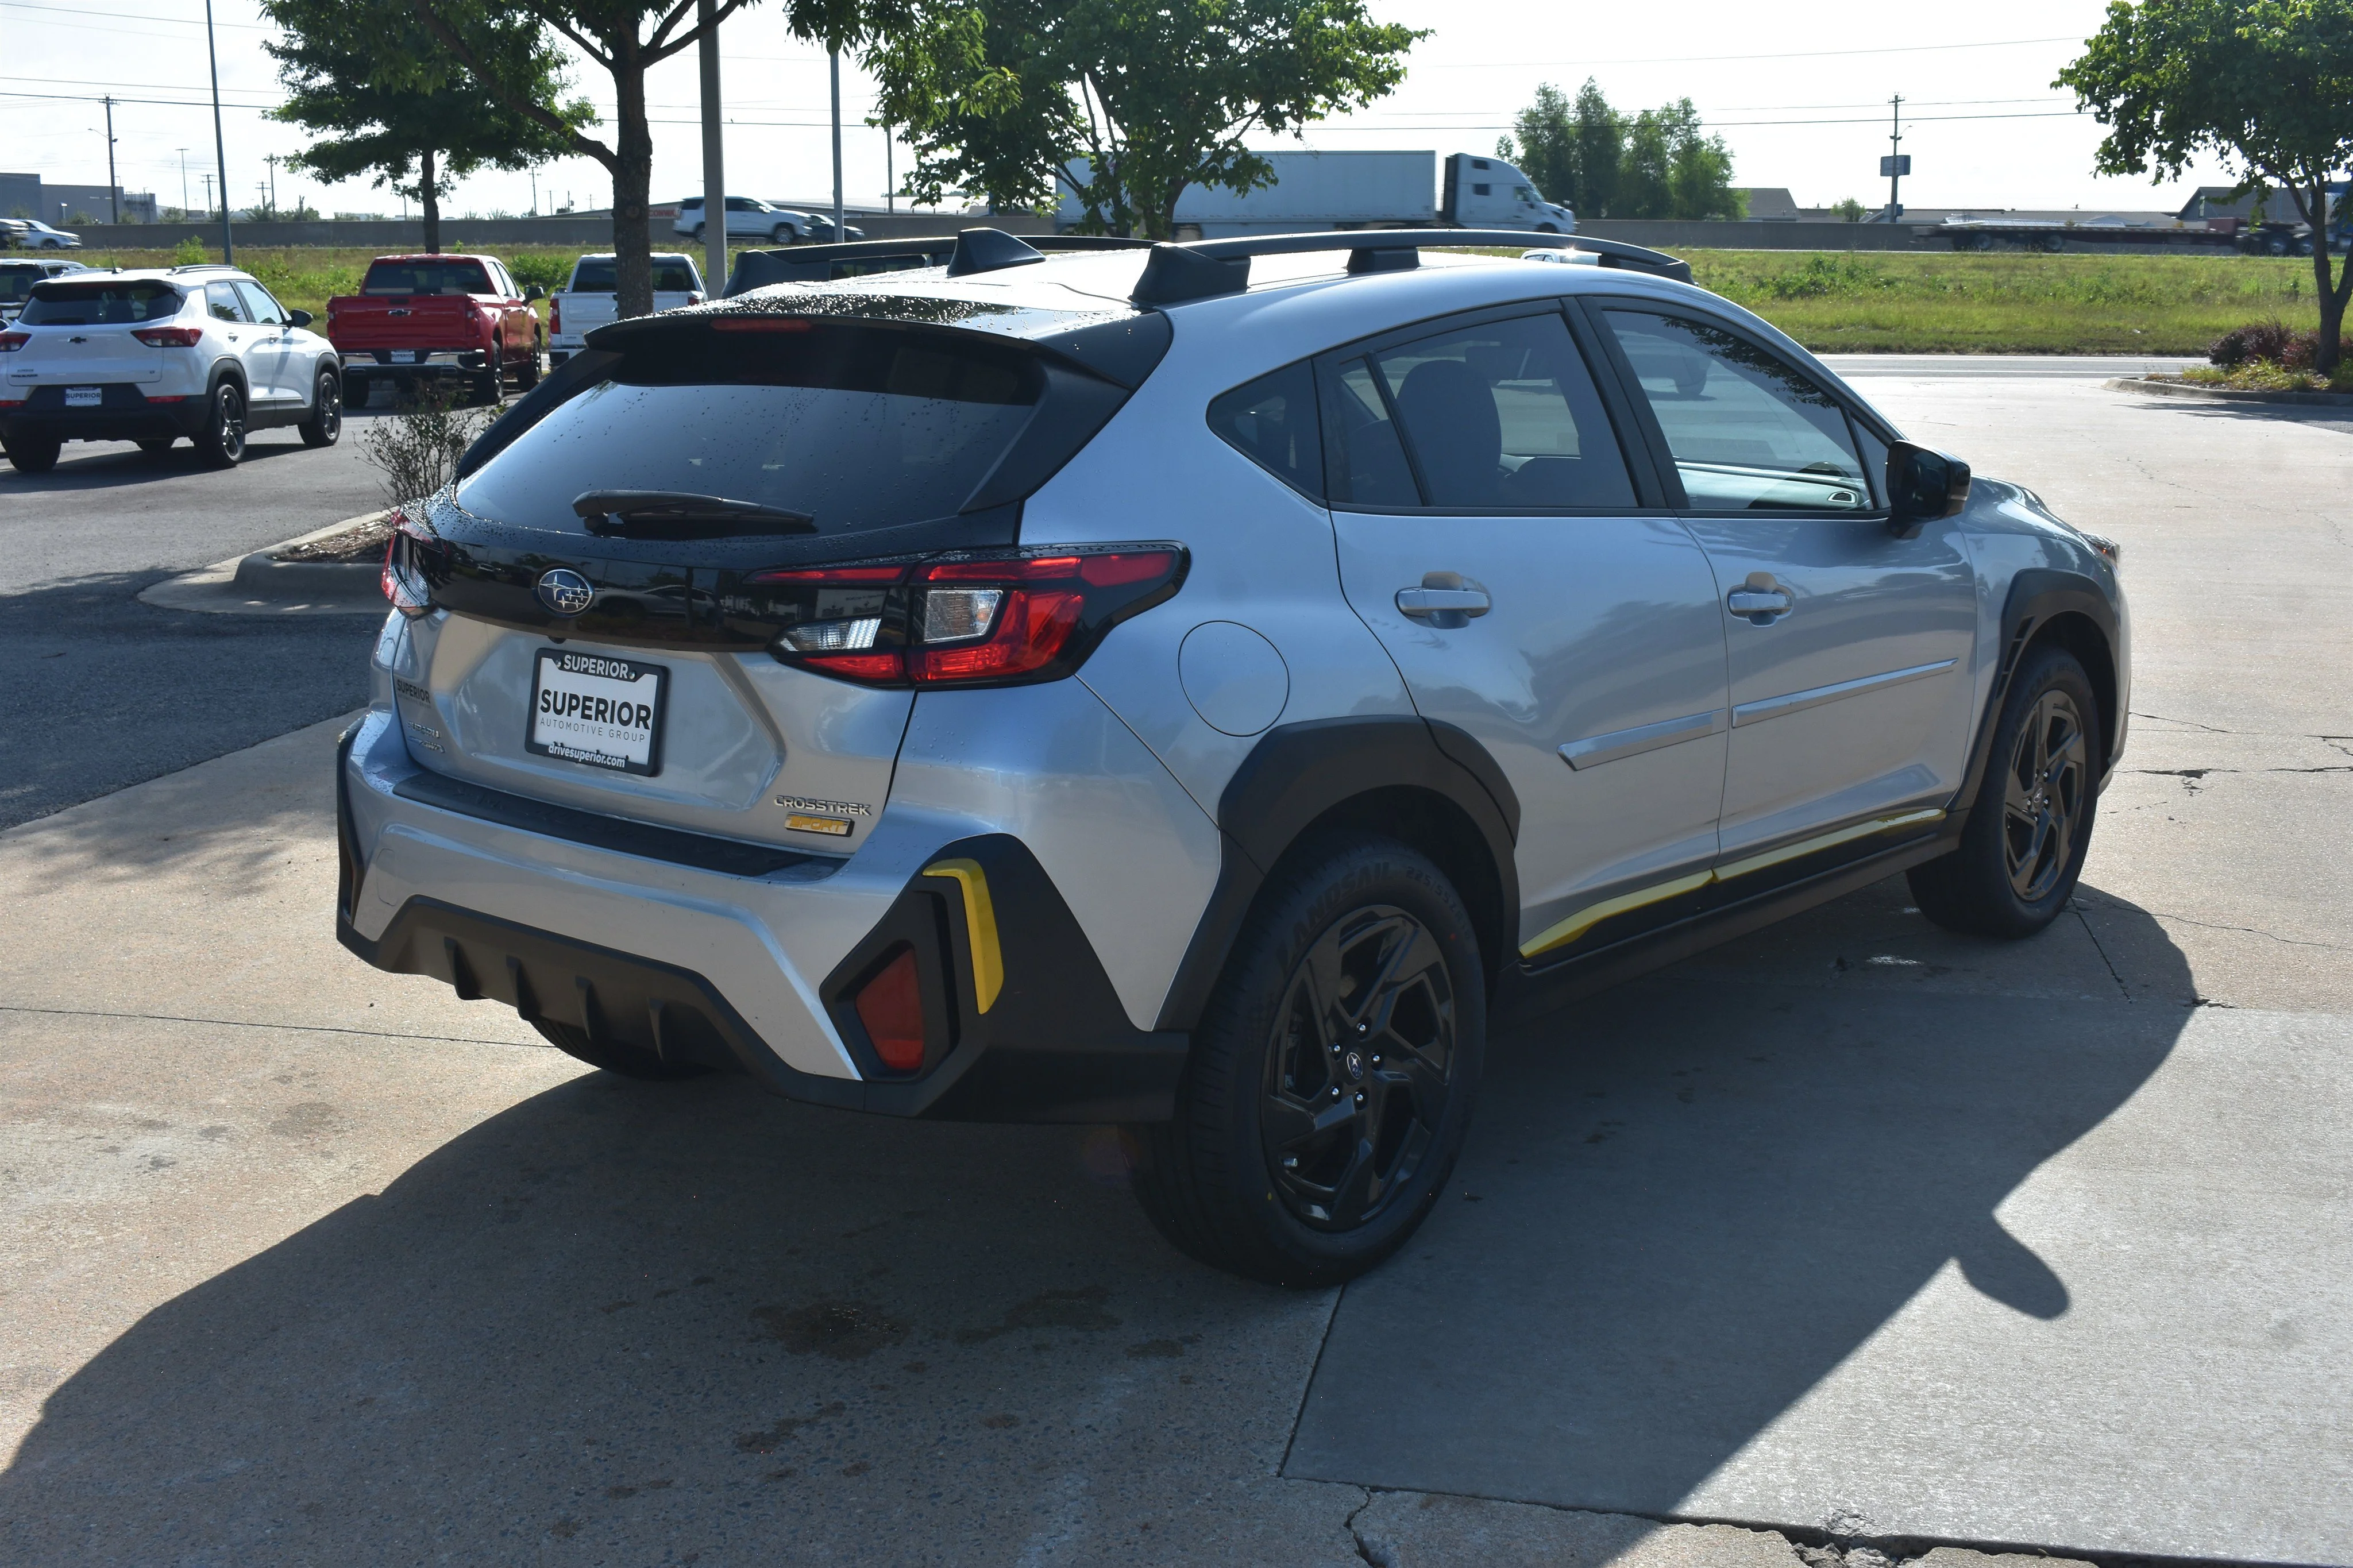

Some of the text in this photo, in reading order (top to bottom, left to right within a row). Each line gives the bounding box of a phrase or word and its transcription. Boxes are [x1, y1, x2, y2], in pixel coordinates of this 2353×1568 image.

[564, 654, 628, 679] SUPERIOR
[397, 679, 430, 704] SUPERIOR
[540, 689, 651, 730] SUPERIOR
[540, 717, 645, 743] AUTOMOTIVE GROUP
[548, 742, 626, 768] drivesuperior.com
[774, 795, 871, 816] CROSSTREK
[789, 816, 845, 832] SPORT
[1275, 861, 1395, 980] LANDSAIL
